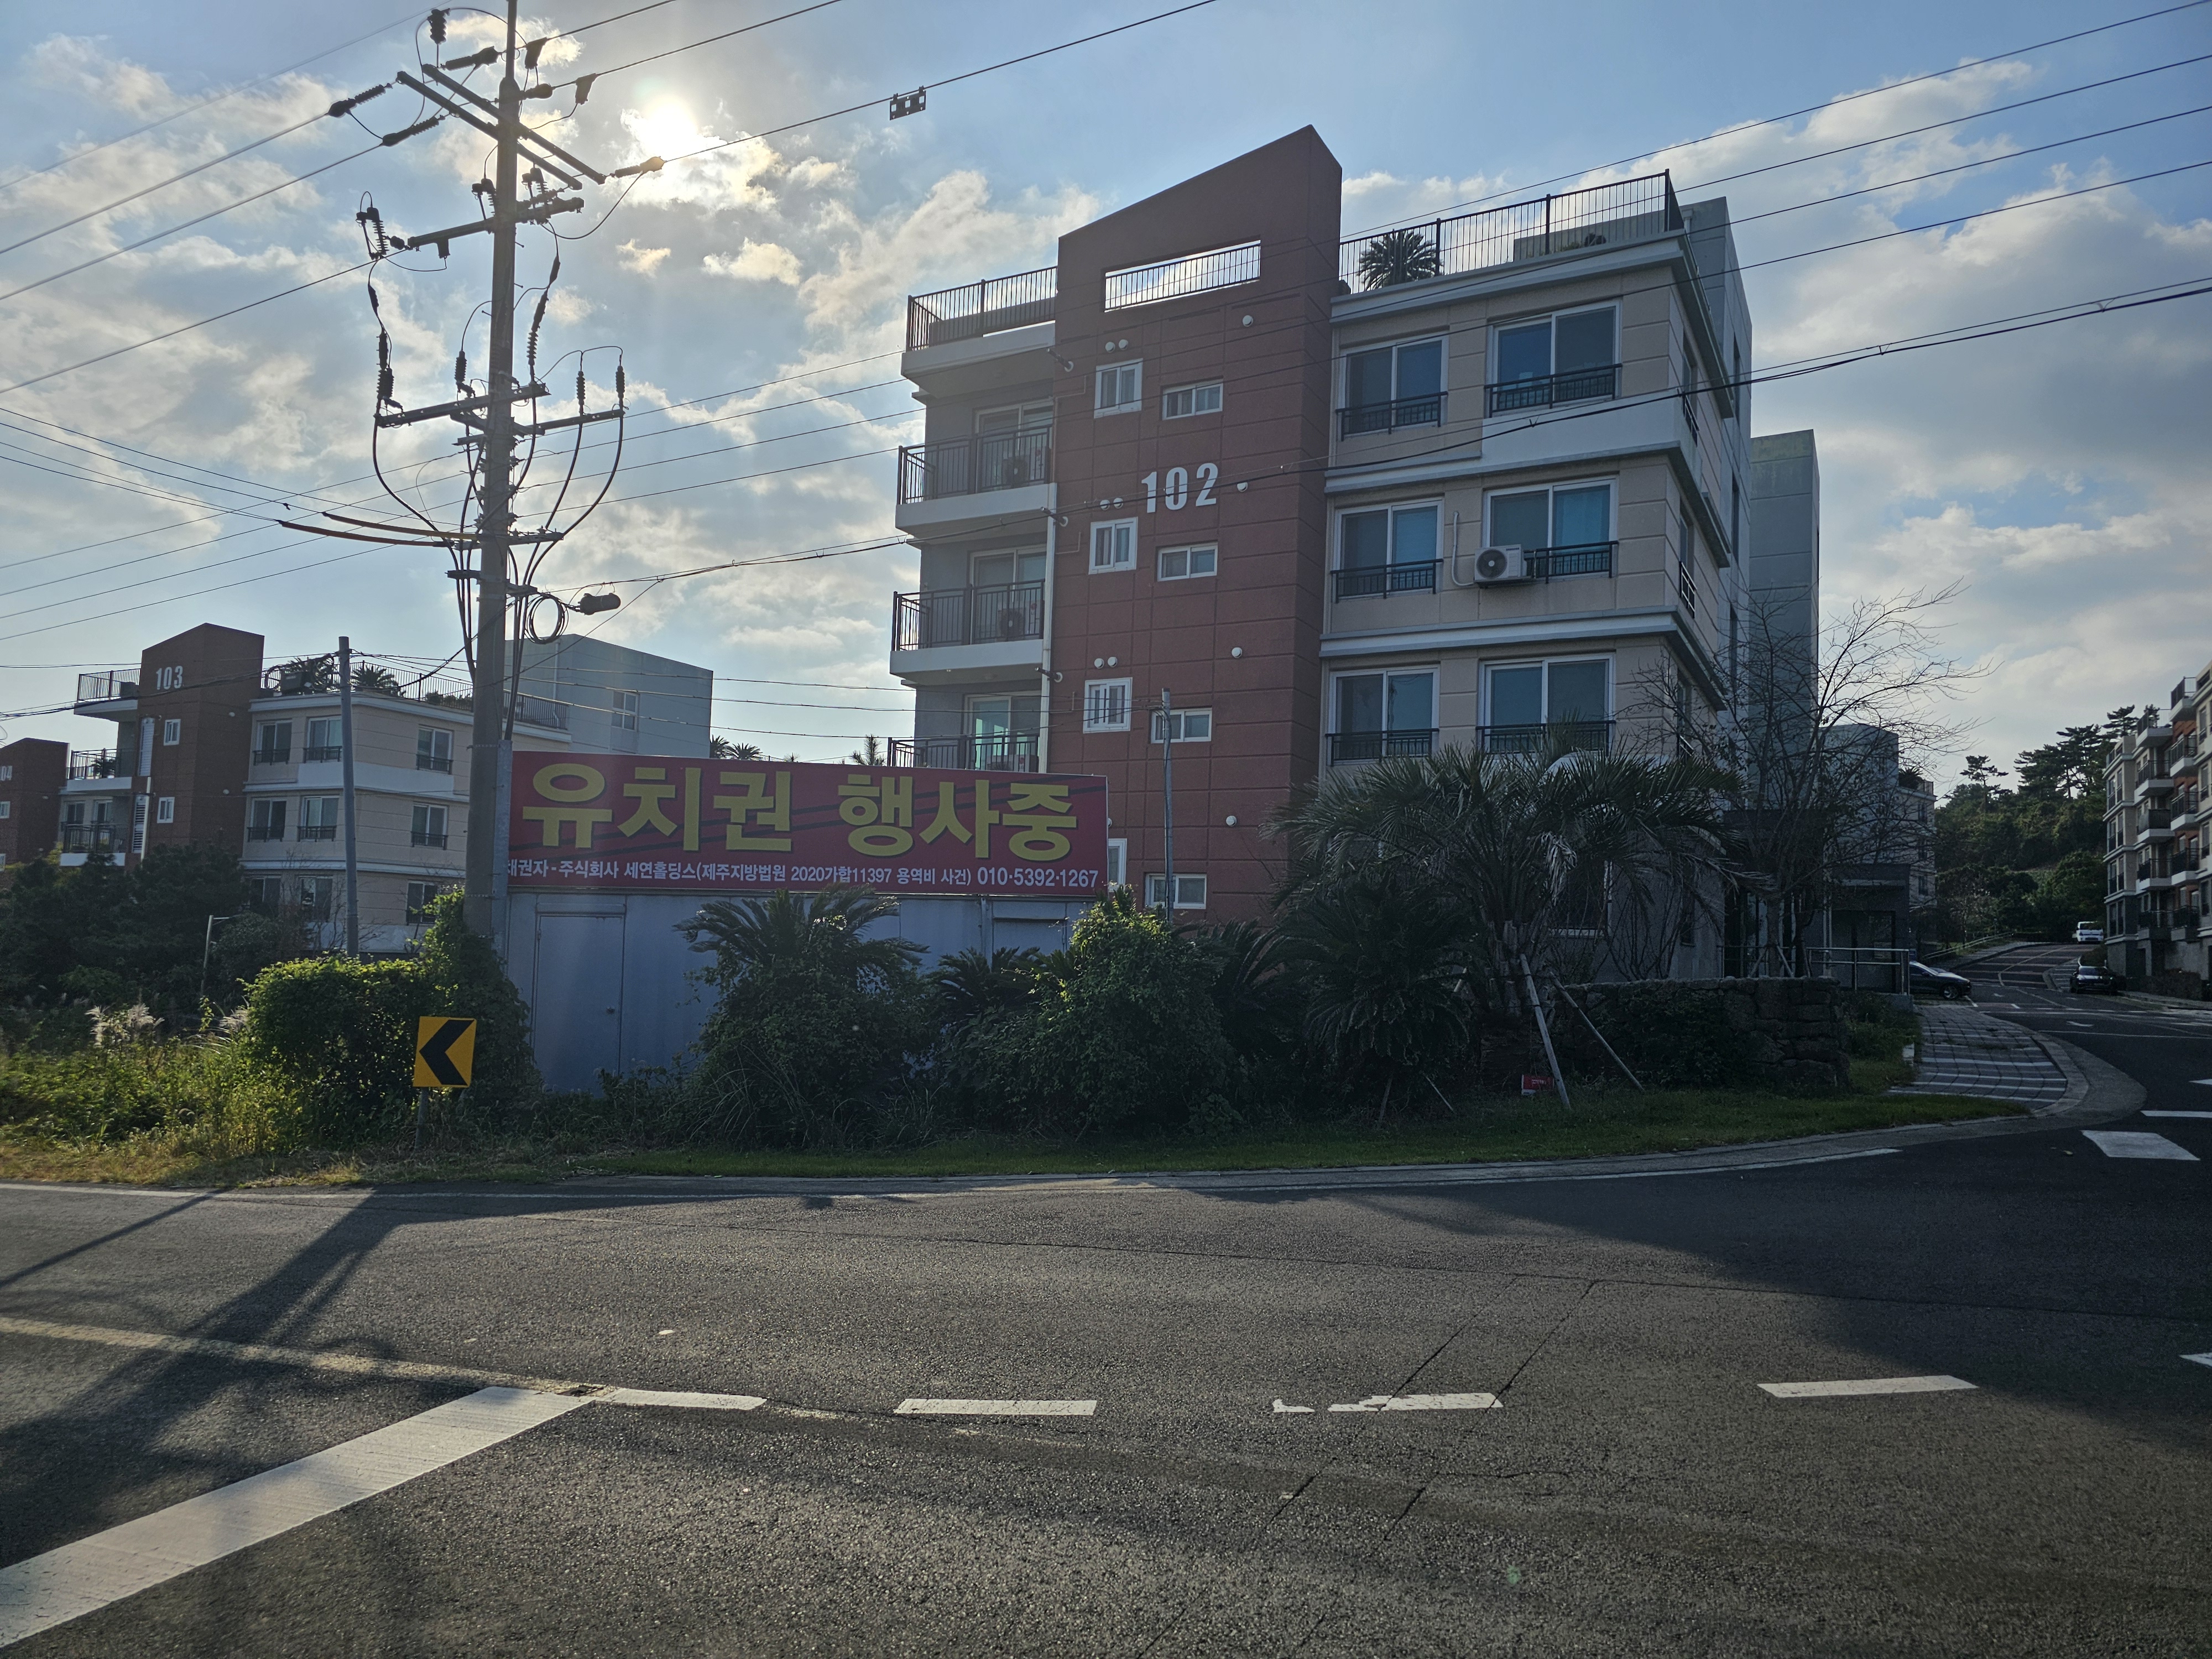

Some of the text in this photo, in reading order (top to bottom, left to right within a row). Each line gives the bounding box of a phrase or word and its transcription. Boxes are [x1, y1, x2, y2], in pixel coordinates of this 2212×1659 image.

[1141, 463, 1218, 513] 102
[156, 665, 183, 690] 103
[0, 765, 13, 781] 04
[523, 763, 1077, 862] 유치권 행사중
[791, 865, 893, 884] 2020가합11397
[896, 867, 936, 885] 용역비
[941, 868, 972, 886] 사건)
